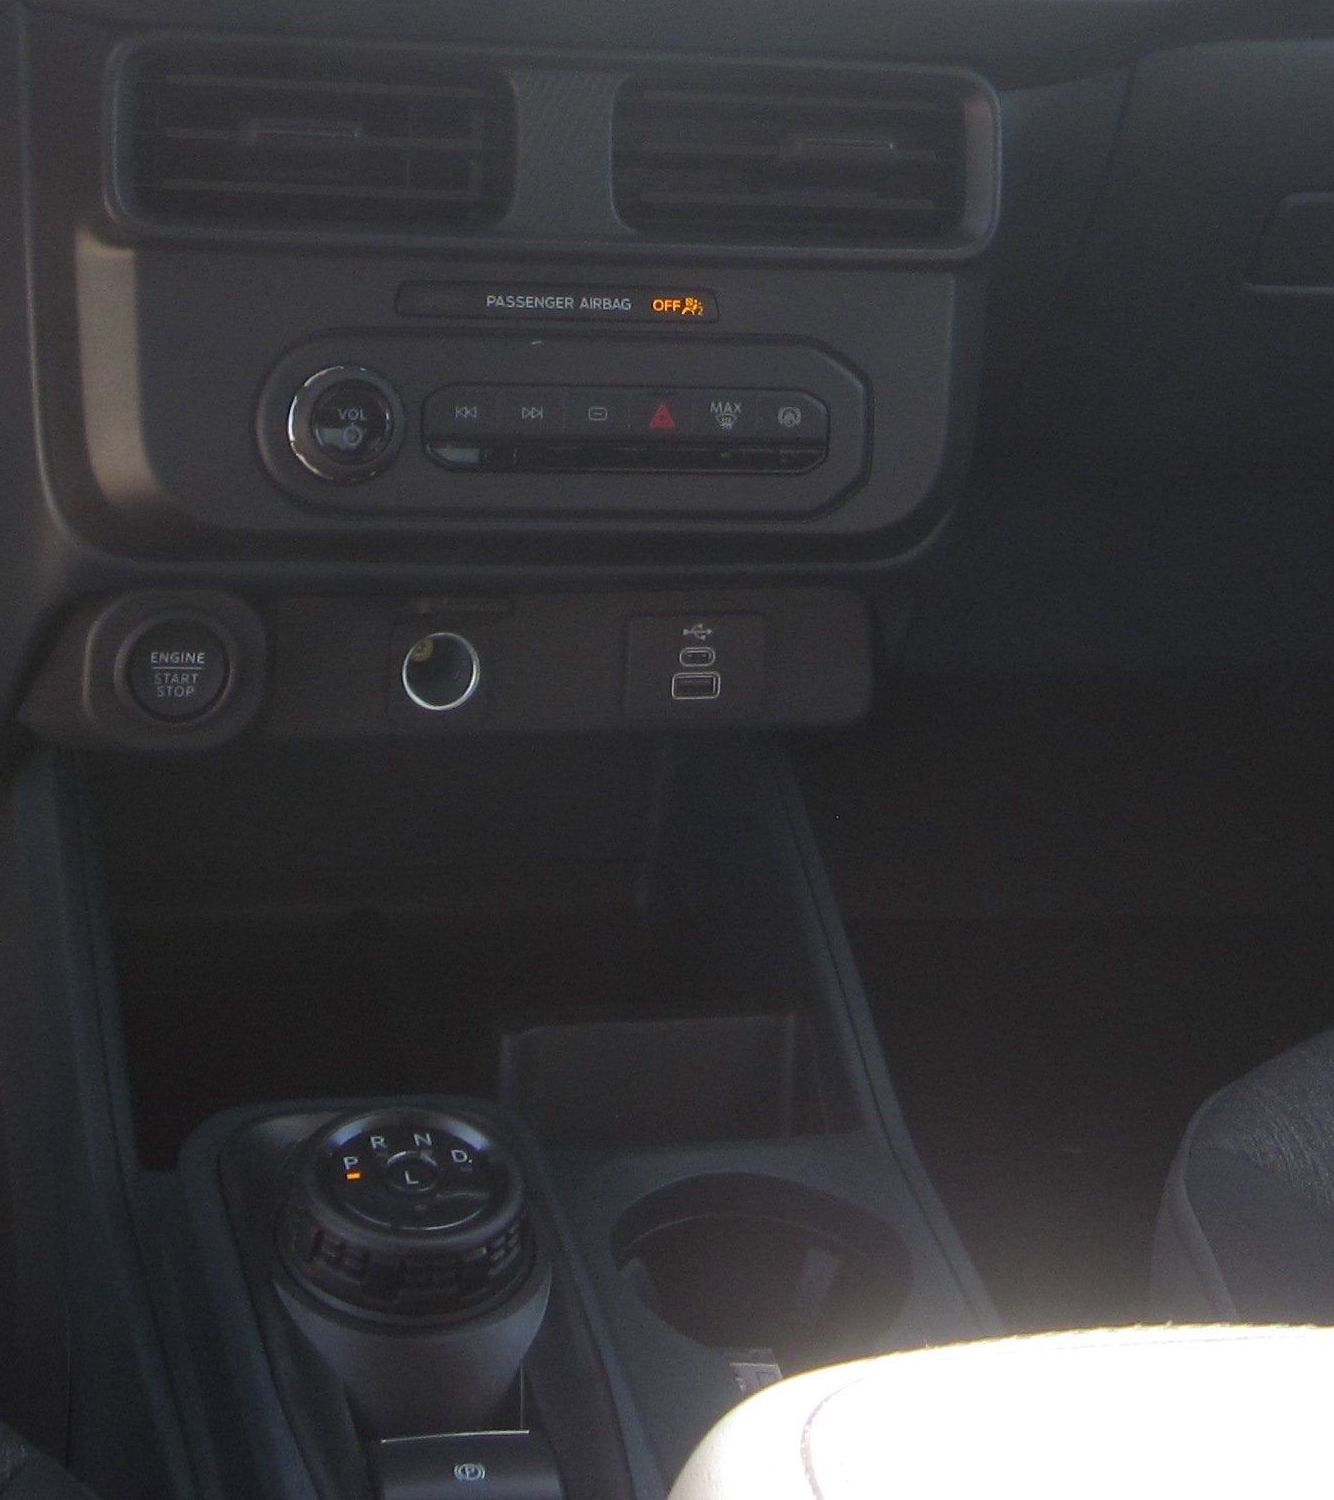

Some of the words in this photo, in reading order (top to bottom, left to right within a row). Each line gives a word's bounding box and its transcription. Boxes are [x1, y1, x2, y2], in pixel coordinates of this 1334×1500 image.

[486, 295, 575, 310] PASSENGER
[579, 297, 632, 311] AIRBAG
[652, 298, 681, 312] OFF
[338, 408, 367, 422] VOL
[709, 402, 743, 415] MAX
[150, 651, 205, 664] ENGINE
[154, 672, 199, 685] START
[156, 685, 196, 698] STOP
[343, 1156, 359, 1170] P
[370, 1135, 387, 1149] R
[413, 1133, 433, 1147] N
[404, 1170, 419, 1185] L
